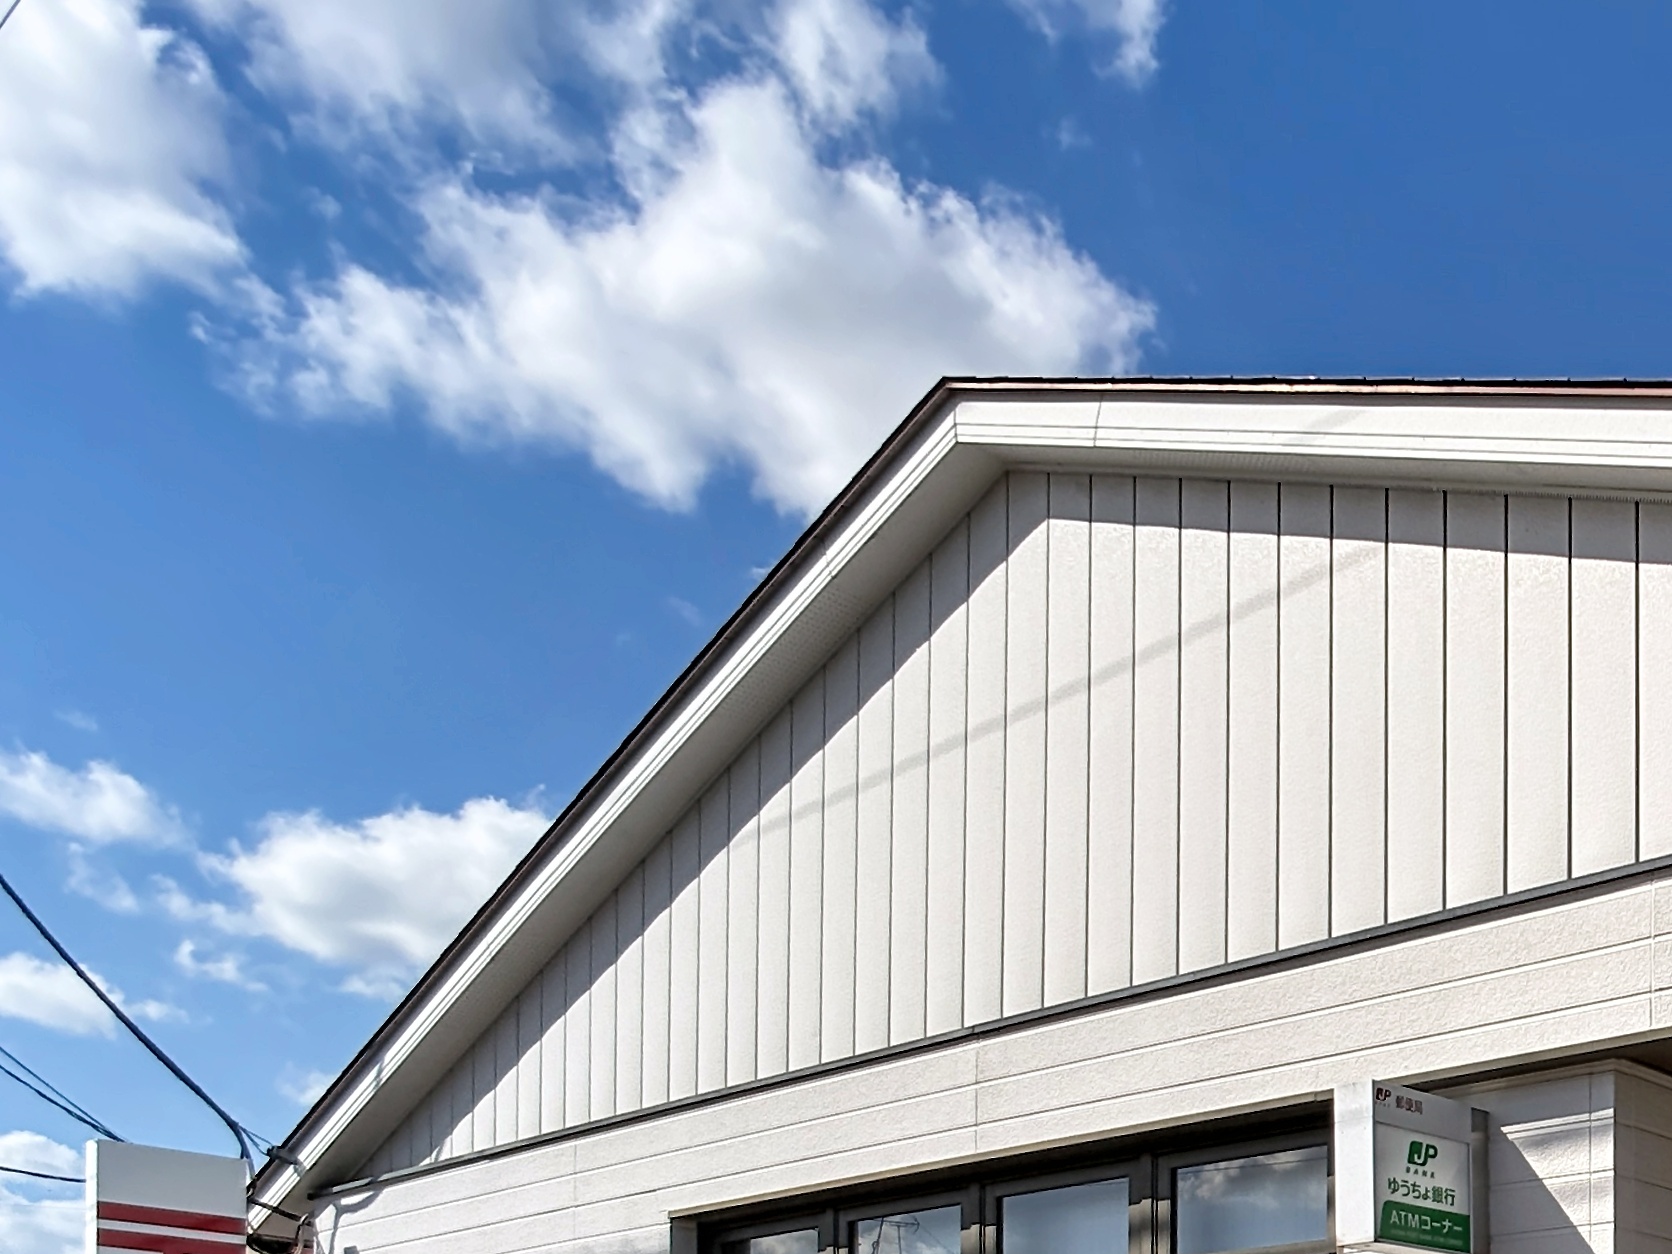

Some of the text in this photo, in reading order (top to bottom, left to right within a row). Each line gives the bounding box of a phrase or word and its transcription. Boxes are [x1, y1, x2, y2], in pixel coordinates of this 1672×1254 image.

[1407, 1140, 1438, 1167] JP
[1387, 1177, 1456, 1207] ゆうちょ銀行
[1390, 1209, 1464, 1234] ATMコーナー
